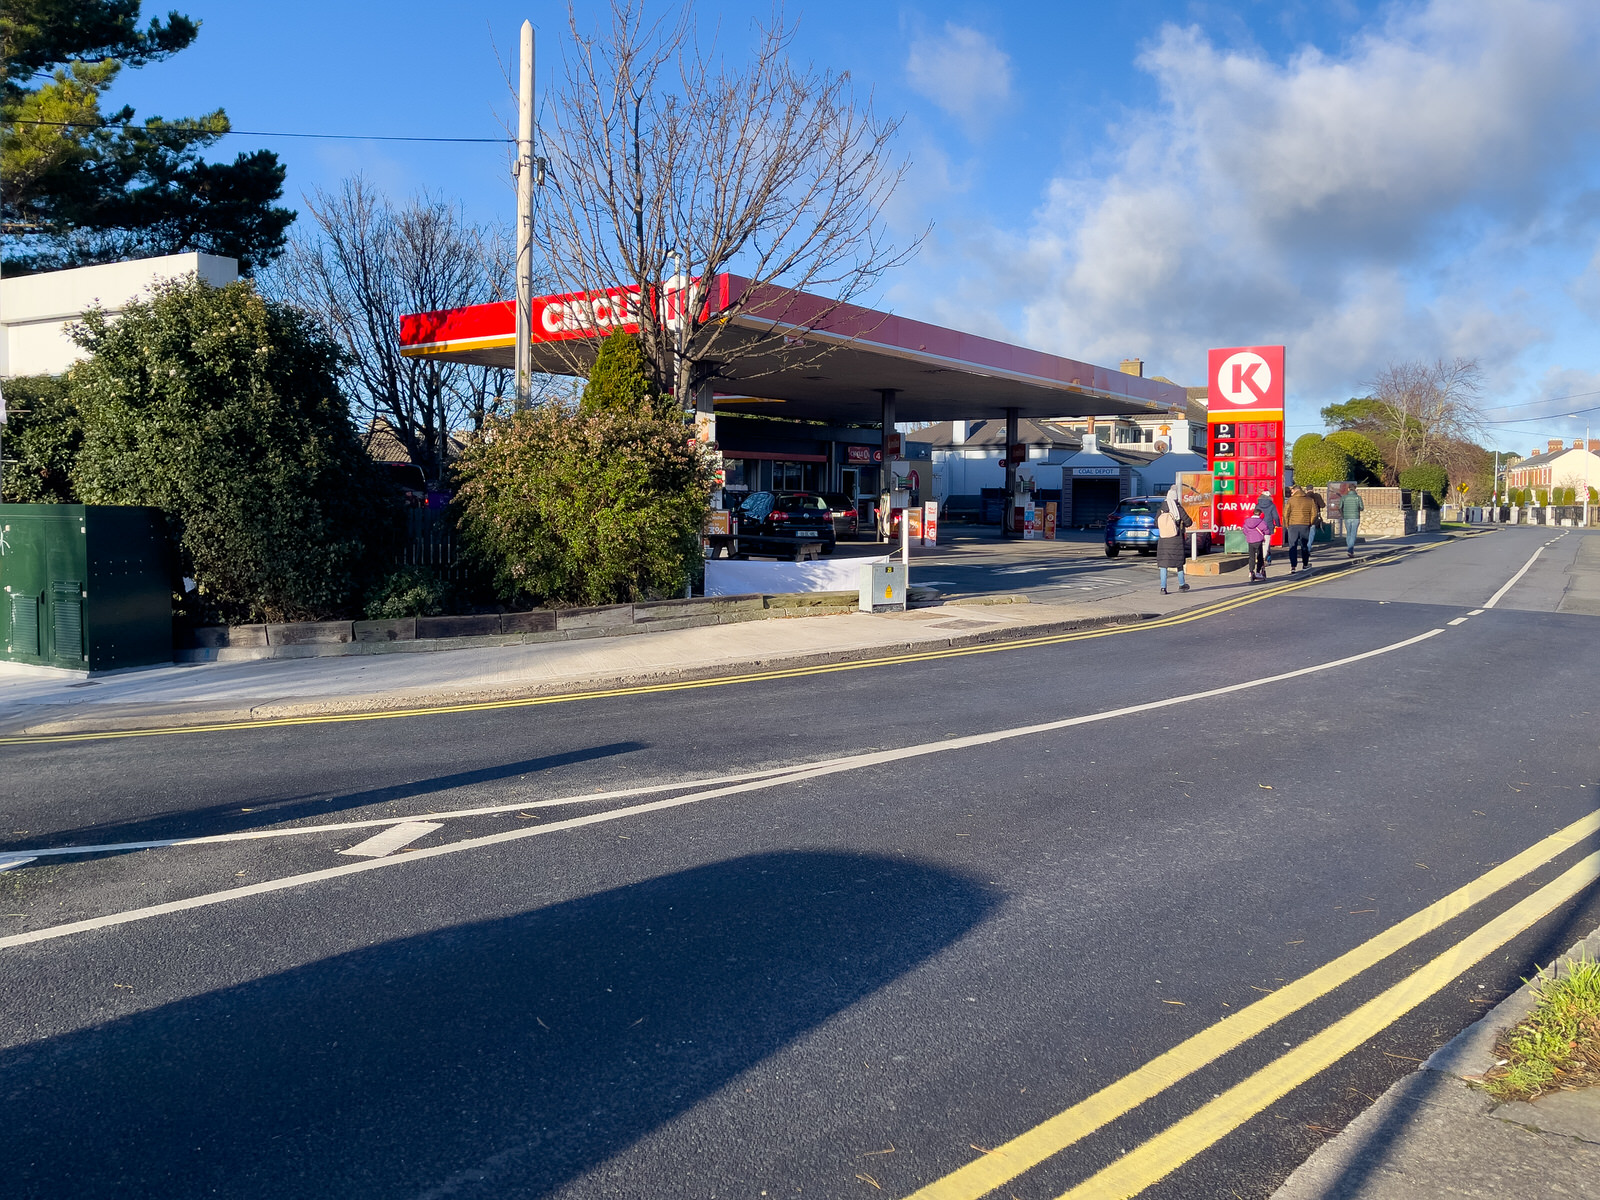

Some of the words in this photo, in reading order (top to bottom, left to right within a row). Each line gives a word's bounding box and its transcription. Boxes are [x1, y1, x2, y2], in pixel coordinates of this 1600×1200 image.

[541, 292, 642, 333] CIRCLE
[1230, 361, 1267, 402] K
[1220, 424, 1229, 433] D
[1220, 442, 1229, 451] D
[1220, 462, 1228, 470] U
[1220, 480, 1228, 489] U
[1216, 502, 1238, 511] CAR
[1239, 502, 1257, 511] WA
